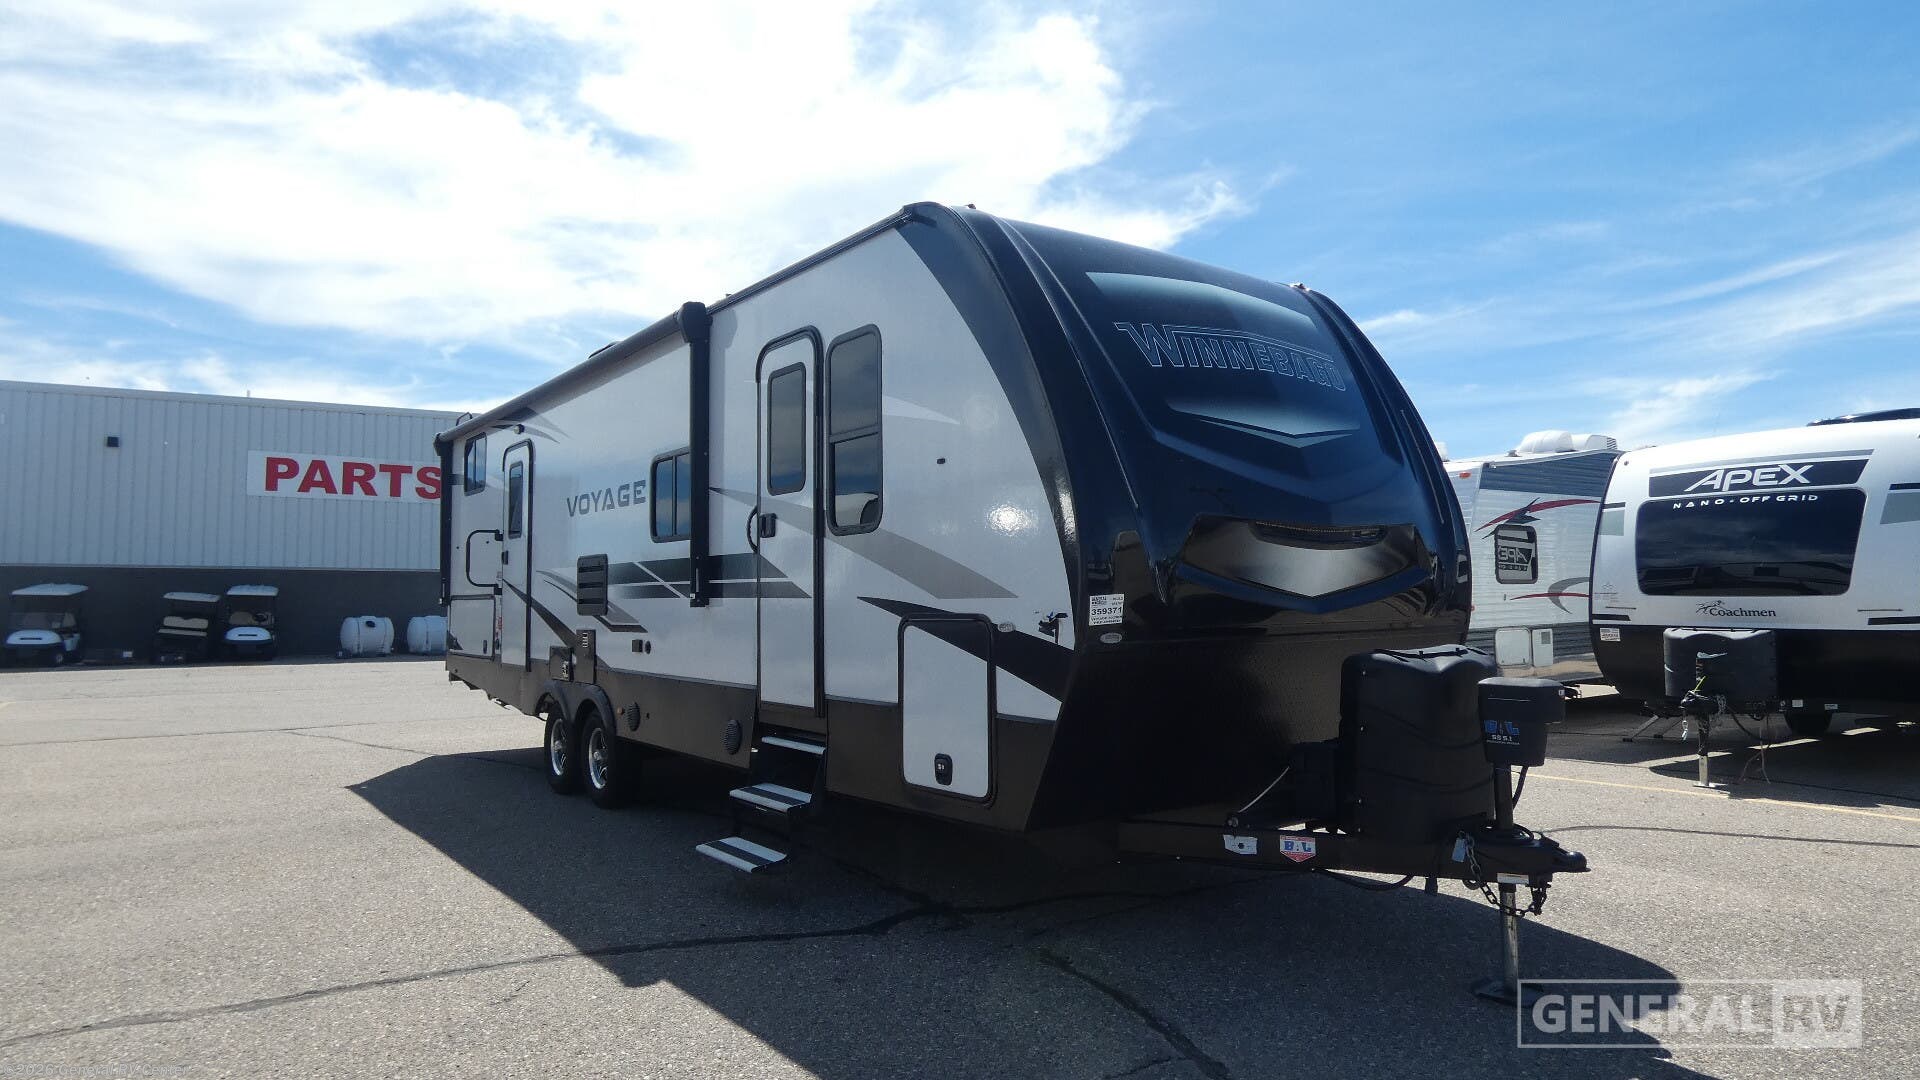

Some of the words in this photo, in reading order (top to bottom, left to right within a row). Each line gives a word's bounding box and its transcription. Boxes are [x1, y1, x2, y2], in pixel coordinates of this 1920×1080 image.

[1113, 322, 1346, 391] WINNEBAGO
[265, 456, 441, 499] PARTS
[1684, 464, 1814, 492] APEX
[566, 479, 646, 517] VOYAGE
[1776, 494, 1818, 502] GRID
[1091, 607, 1122, 616] 359371
[1709, 607, 1777, 617] Coachmen
